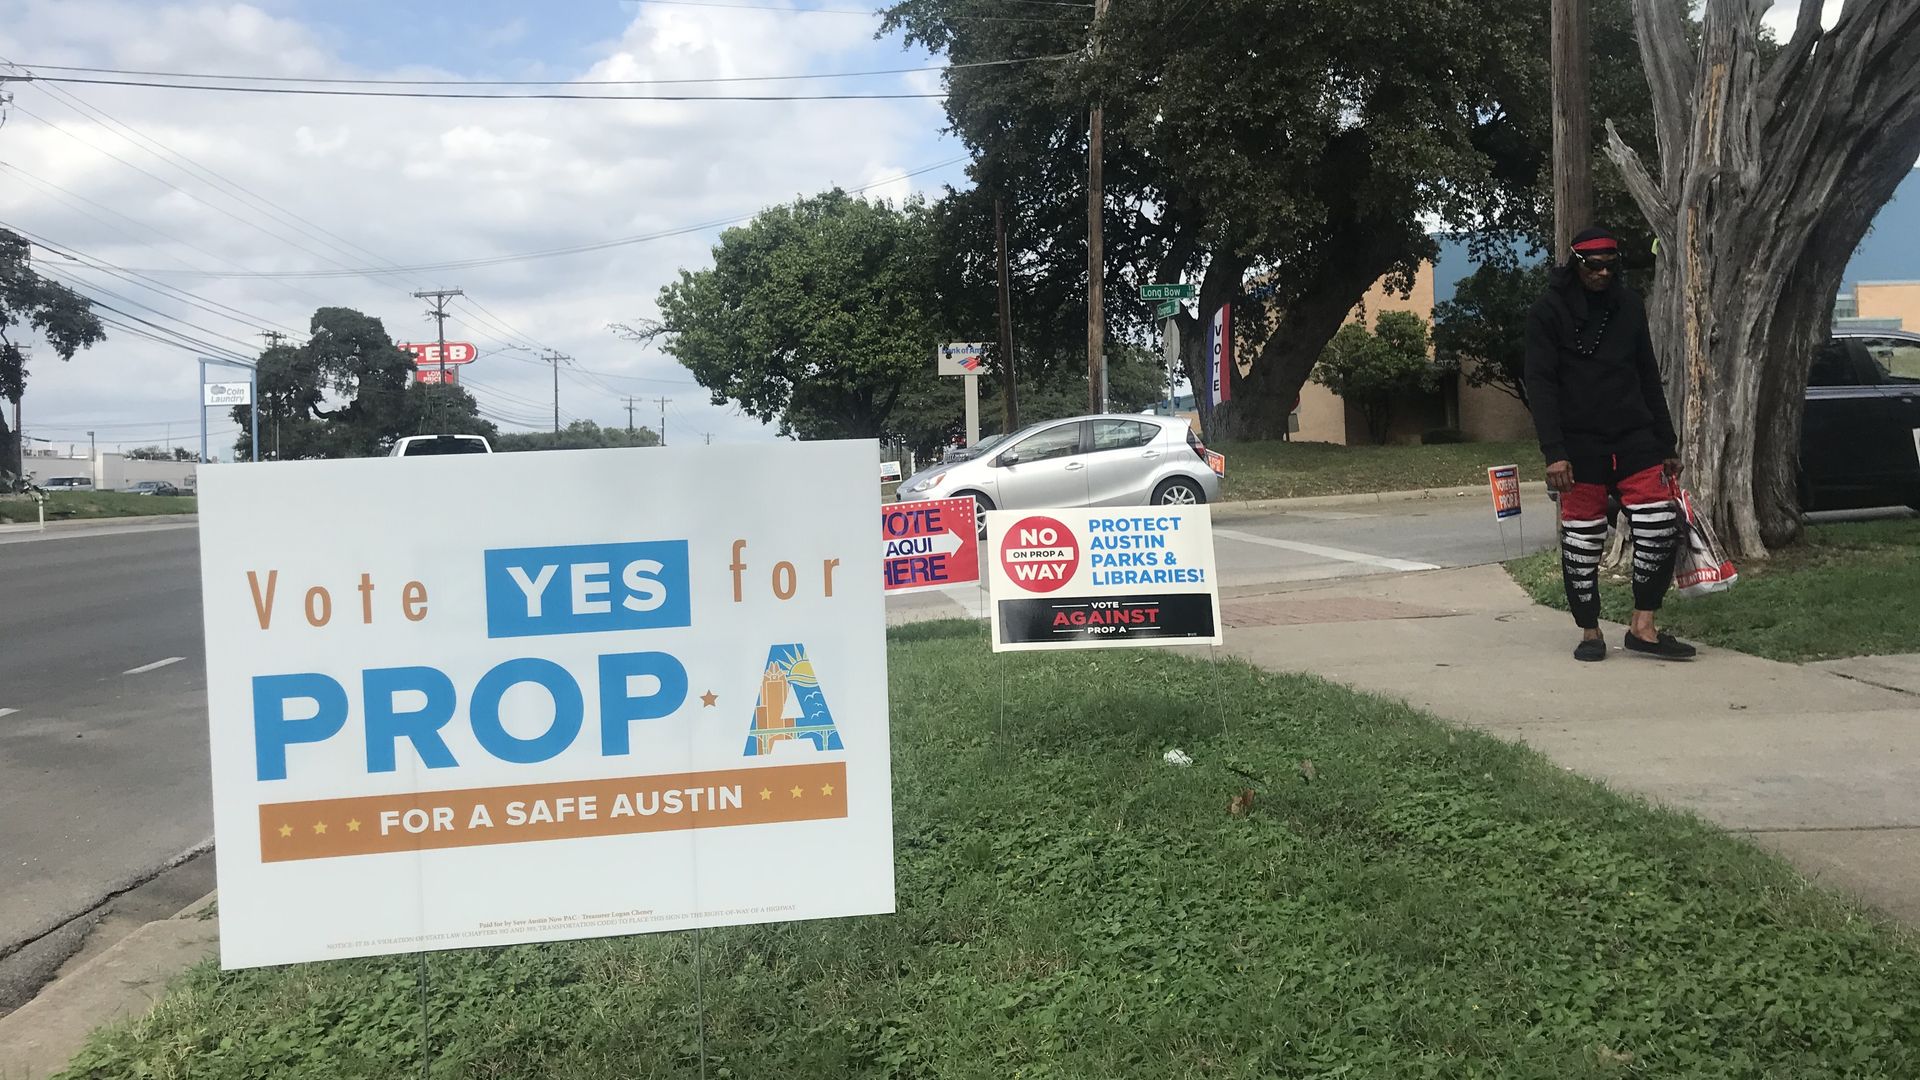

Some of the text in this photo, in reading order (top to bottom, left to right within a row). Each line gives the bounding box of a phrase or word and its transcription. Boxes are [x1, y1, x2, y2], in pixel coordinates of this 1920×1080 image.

[1142, 287, 1162, 298] Long
[1164, 287, 1181, 296] Bow
[1213, 324, 1222, 392] VOTE
[210, 395, 245, 403] Laundry
[226, 388, 245, 396] Coin
[882, 509, 943, 536] OTE
[1088, 517, 1182, 533] PROTECT
[1020, 527, 1058, 546] NO
[1090, 534, 1165, 551] AUSTIN
[886, 537, 933, 557] AQUI
[1013, 549, 1065, 559] ON PROP A
[1091, 551, 1177, 568] PARKS &
[1014, 563, 1068, 581] WAY
[1092, 568, 1205, 586] LIBRARIES!
[246, 539, 840, 630] Vote YES for
[1091, 601, 1120, 609] VOTE
[1052, 608, 1160, 627] AGAINST
[1087, 625, 1127, 634] PROP A
[252, 643, 845, 782] PROP A
[379, 784, 743, 836] FOR A SAFE AUSTIN
